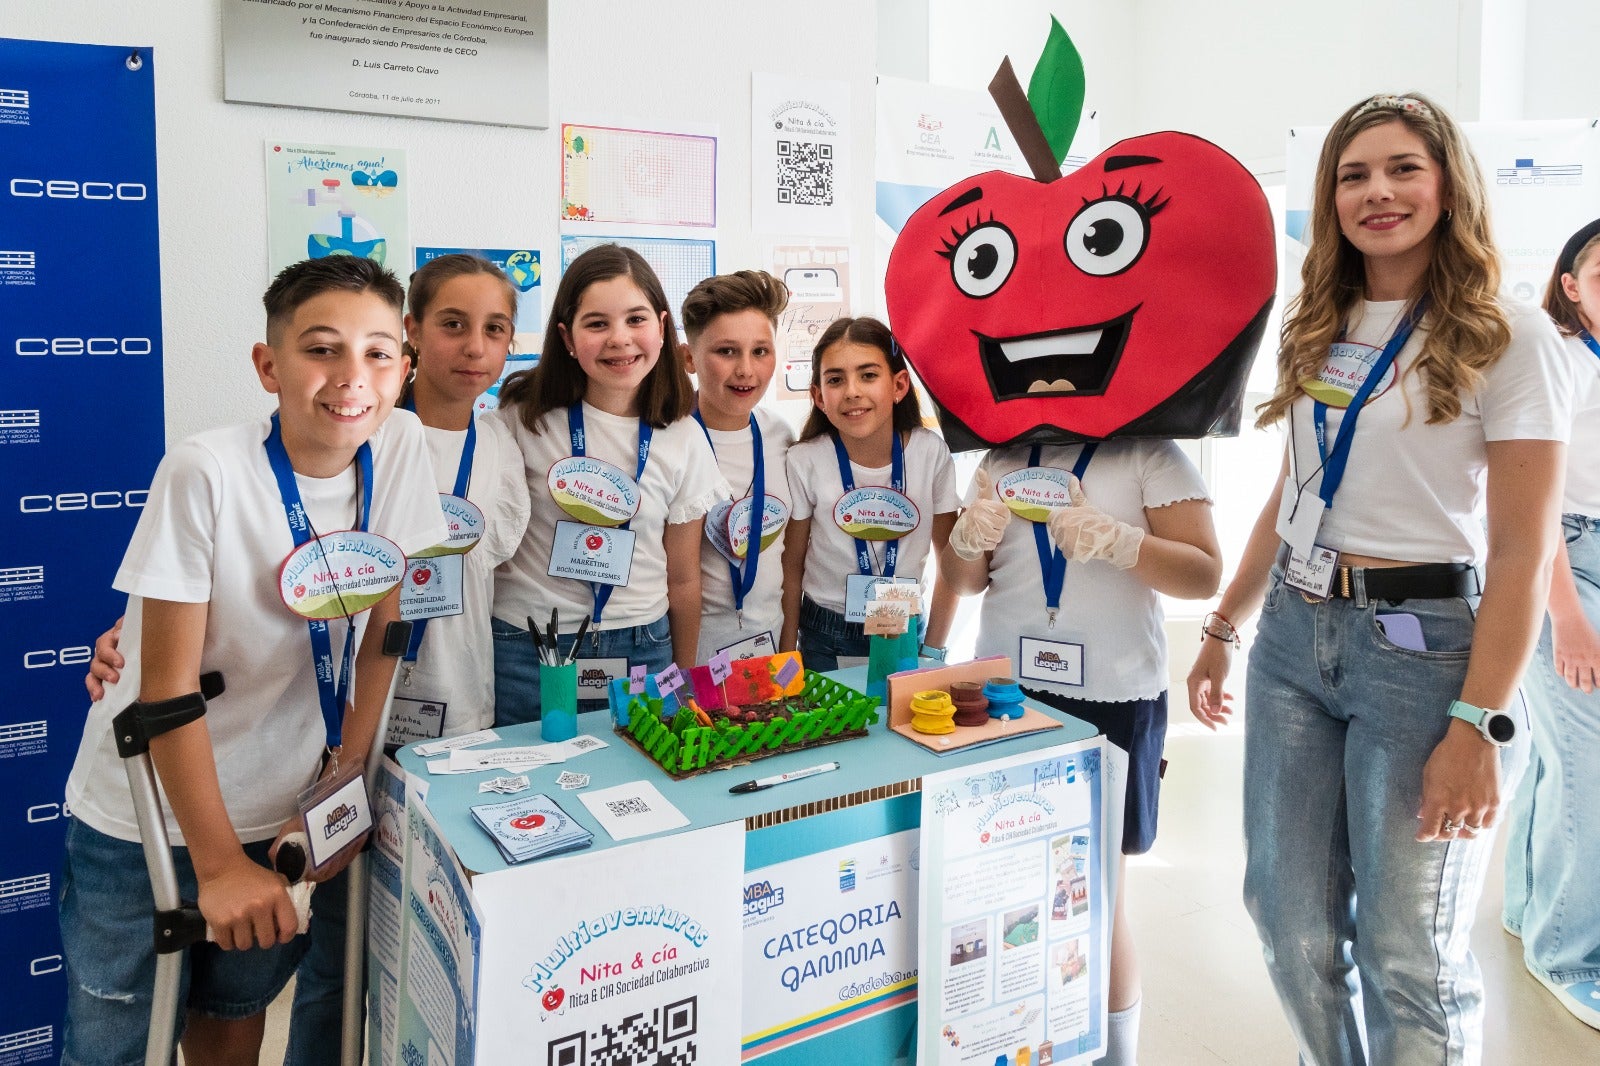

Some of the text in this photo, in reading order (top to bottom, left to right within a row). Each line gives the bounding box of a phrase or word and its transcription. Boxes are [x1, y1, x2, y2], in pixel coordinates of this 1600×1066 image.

[405, 2, 429, 10] Apoyo
[447, 6, 481, 16] Actividad
[318, 18, 378, 32] Confederación
[380, 25, 390, 33] de
[392, 26, 440, 39] Empresarios
[442, 32, 451, 40] de
[324, 6, 371, 16] Mecanismo
[373, 10, 414, 22] Financiero
[415, 15, 428, 23] del
[430, 18, 459, 28] Espacio
[461, 21, 502, 32] Económico
[504, 26, 534, 36] Europeo
[309, 31, 477, 56] fue inaugurado siendo Presidente de CECO
[352, 59, 439, 75] D. Luis Carreto Clavo
[400, 95, 413, 103] julio
[920, 132, 941, 145] CEA
[357, 157, 385, 170] agua!
[1323, 365, 1367, 382] Nita & cí
[555, 461, 634, 506] Multiaventuras
[573, 480, 619, 503] Nita & cía
[1022, 488, 1040, 498] Nita
[1053, 491, 1064, 499] cía
[838, 491, 914, 519] Multiaventuras
[858, 509, 875, 517] Nita
[889, 511, 899, 519] cía
[289, 510, 298, 528] MBA
[284, 539, 397, 588] Multiaventuras
[571, 558, 610, 568] MARKETING
[313, 563, 375, 584] Nita & cía
[336, 579, 361, 592] Sociedad
[361, 575, 400, 587] Colaborativa
[575, 568, 596, 577] MUÑOZ
[597, 573, 621, 581] LESMES
[399, 595, 446, 606] OSTENIBILIDAD
[407, 604, 459, 616] CANO FERNÁNDEZ
[24, 645, 92, 669] ce
[1039, 651, 1060, 662] MBA
[583, 669, 605, 679] MBA
[327, 803, 348, 825] MBA
[995, 812, 1041, 832] Nita & cía
[743, 881, 772, 901] MBA
[743, 887, 784, 916] eaguE
[521, 904, 709, 993] Multiaventuras
[581, 943, 677, 985] Nita & cía
[569, 958, 710, 1008] Nita & CIA Sociedad Colaborativa
[839, 971, 902, 1001] Córdoba
